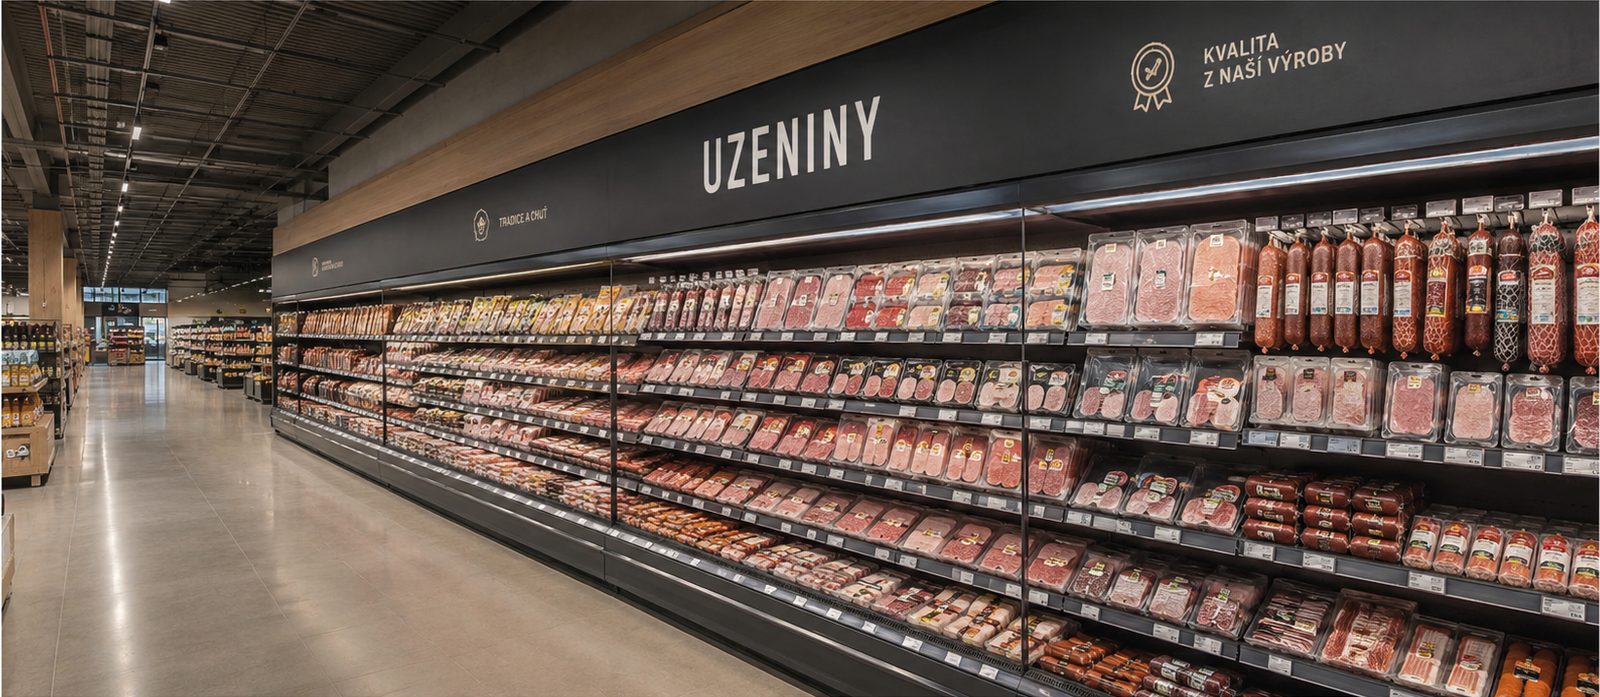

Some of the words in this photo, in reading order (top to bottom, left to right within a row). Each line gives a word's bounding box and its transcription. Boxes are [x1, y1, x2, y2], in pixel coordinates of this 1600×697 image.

[1203, 32, 1279, 64] KVALITA
[1203, 70, 1214, 88] Z
[1219, 56, 1262, 85] NAŠÍ
[1268, 41, 1347, 74] VÝROBY
[703, 95, 881, 194] UZENINY
[499, 213, 525, 228] TRADICE
[525, 212, 531, 222] A
